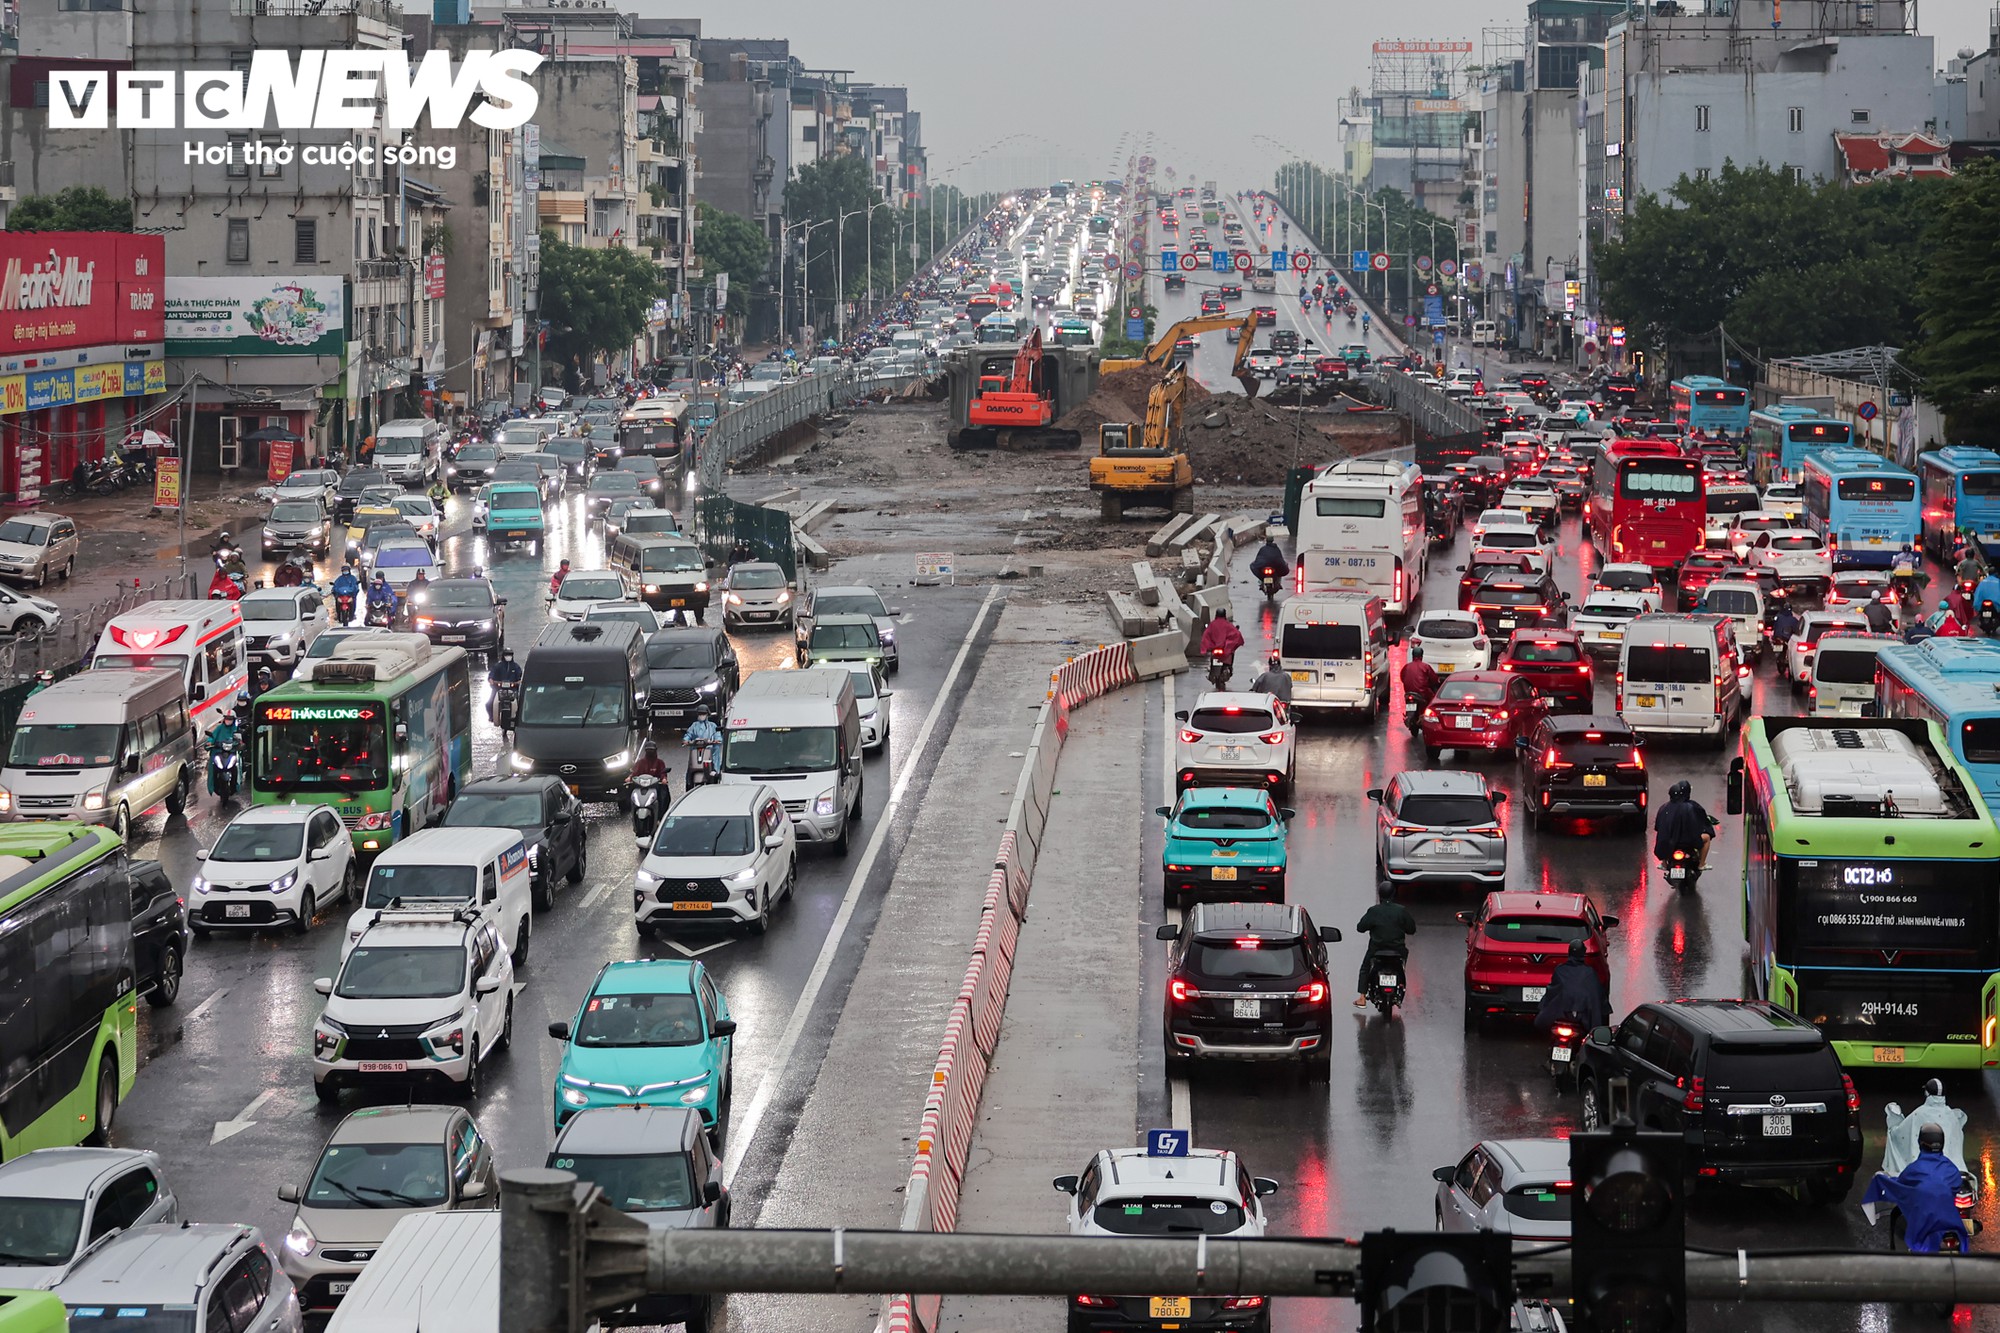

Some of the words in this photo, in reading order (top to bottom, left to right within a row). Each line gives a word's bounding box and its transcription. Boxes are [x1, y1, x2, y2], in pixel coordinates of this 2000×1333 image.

[1404, 43, 1426, 51] 0916
[135, 255, 148, 277] BÁN
[1185, 258, 1194, 266] 60
[1239, 258, 1248, 266] 60
[1298, 258, 1307, 266] 60
[1377, 258, 1386, 266] 40
[190, 299, 214, 308] THỰC
[215, 297, 240, 307] PHẨM
[102, 370, 107, 395] 2
[108, 369, 122, 394] triệu
[50, 377, 56, 402] 2
[56, 374, 72, 402] triệu
[6, 384, 24, 408] 10%
[986, 406, 1023, 414] DAEWOO
[1871, 482, 1882, 491] 52
[1325, 558, 1340, 567] 29K
[1348, 558, 1376, 568] 087.15
[266, 708, 291, 720] 142
[291, 708, 326, 719] THĂNG
[328, 709, 358, 719] LONG
[343, 806, 362, 814] BUS
[1830, 914, 1846, 925] 0866
[1848, 914, 1861, 925] 355
[1862, 914, 1874, 926] 222
[1240, 1001, 1254, 1009] 30E
[1862, 1002, 1918, 1016] 29H-914.45
[1234, 1009, 1259, 1018] 864.44
[1770, 1116, 1785, 1125] 30G
[1764, 1126, 1792, 1135] 420.05
[1162, 1298, 1178, 1307] 29E
[1154, 1307, 1186, 1316] 780.67
